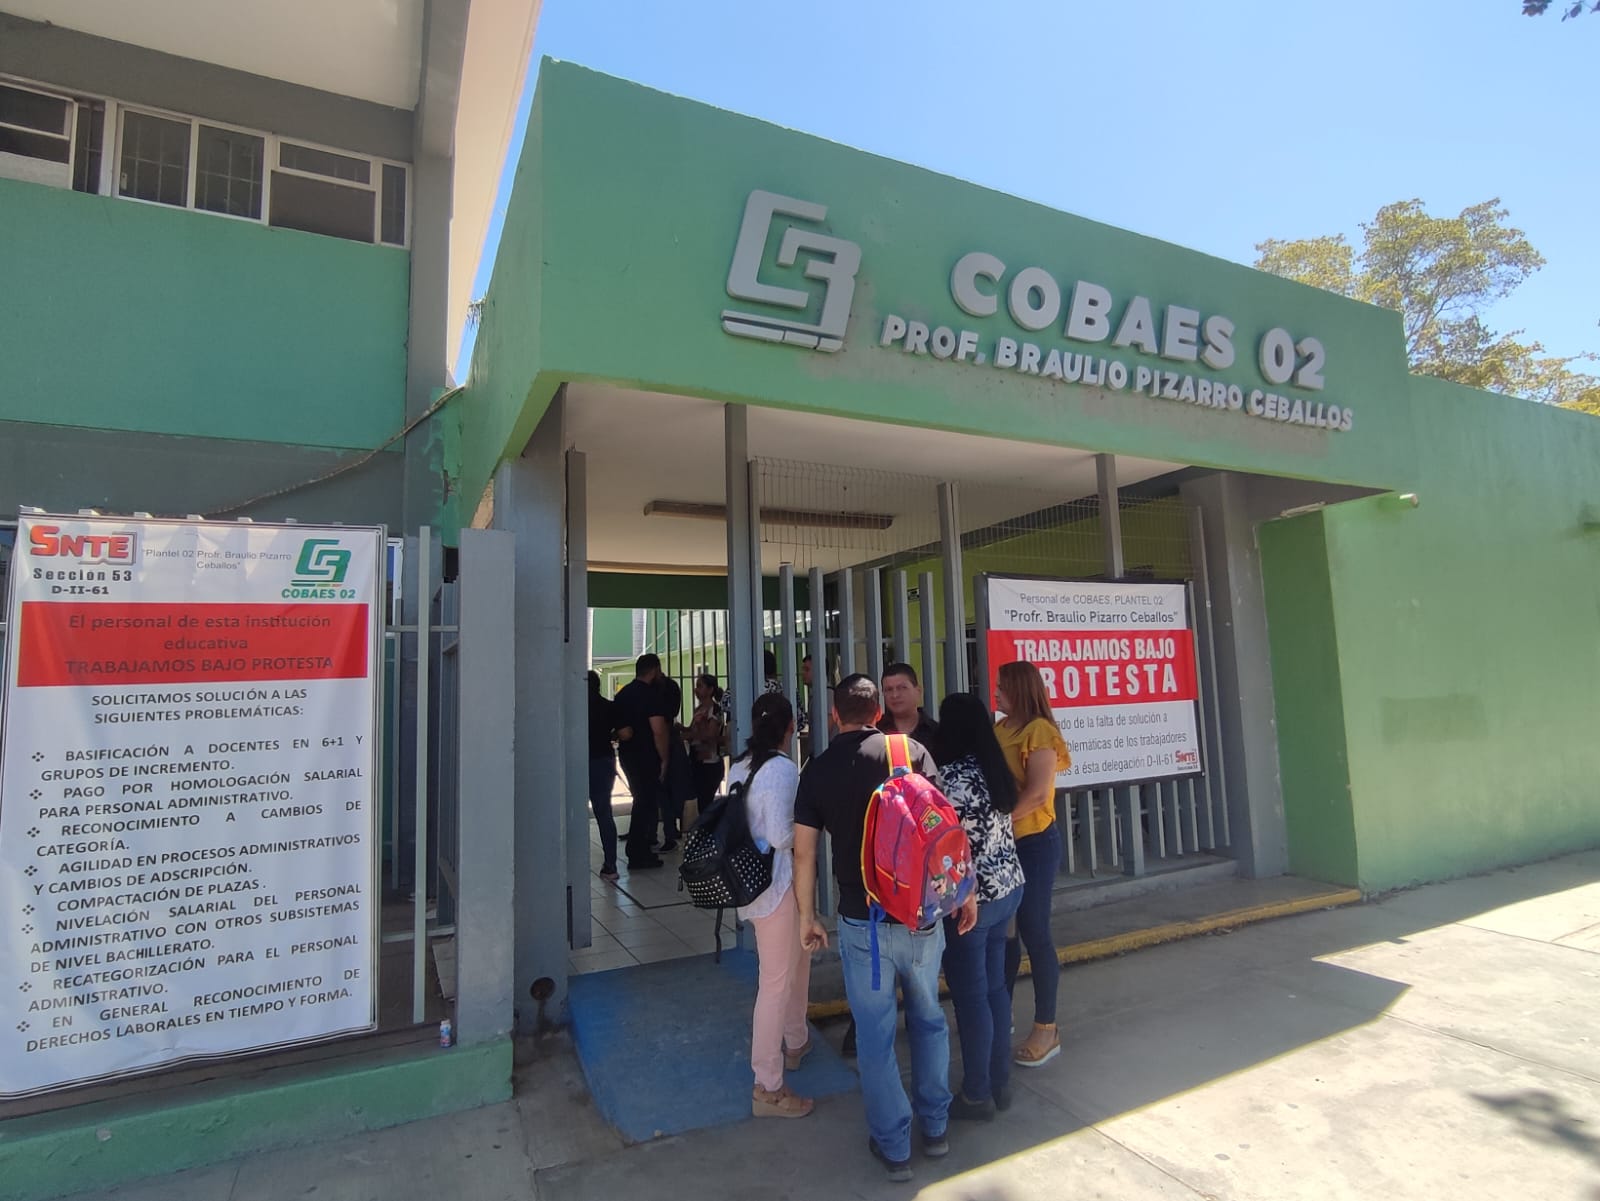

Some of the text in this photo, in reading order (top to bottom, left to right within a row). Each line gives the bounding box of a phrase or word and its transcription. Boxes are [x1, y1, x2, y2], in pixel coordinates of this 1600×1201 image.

[951, 252, 1325, 390] COBAES 02
[880, 314, 1353, 431] PROF. BRAULIO PIZARRO CEBALLOS
[30, 525, 130, 560] SNTE
[182, 550, 194, 558] 02
[225, 551, 257, 560] Braulio
[259, 551, 292, 561] Pizarro
[112, 570, 132, 581] 53
[51, 585, 109, 594] D-II-61
[281, 588, 356, 600] COBAES 02
[1020, 592, 1058, 605] Personal
[1061, 593, 1070, 605] de
[1115, 595, 1151, 605] PLANTEL
[1153, 596, 1164, 605] 02
[69, 614, 331, 631] El personal de esta institución
[1047, 610, 1086, 623] Braulio
[1090, 611, 1128, 623] Pizarro
[164, 637, 248, 650] educativa
[1014, 637, 1175, 663] TRABAJAMOS BAJO
[65, 656, 333, 674] TRABAJAMOS BAJO PROTESTA
[1039, 663, 1178, 699] ROTESTA
[91, 688, 307, 707] SOLICITAMOS SOLUCIÓN A LAS
[95, 705, 304, 724] SIGUIENTES PROBLEMÁTICAS:
[1074, 715, 1084, 728] de
[1087, 714, 1094, 728] la
[1096, 713, 1114, 727] falta
[1116, 713, 1126, 726] de
[1128, 711, 1161, 725] solución
[65, 735, 363, 762] BASIFICACIÓN A DOCENTES EN 6+1 Y
[1114, 736, 1124, 749] de
[1126, 735, 1138, 747] los
[1140, 731, 1187, 747] trabajadores
[41, 760, 235, 782] GRUPOS DE INCREMENTO.
[1102, 756, 1145, 773] delegación
[63, 767, 363, 799] PAGO POR HOMOLOGACIÓN SALARIAL
[39, 789, 294, 819] PARA PERSONAL ADMINISTRATIVO.
[61, 800, 362, 837] RECONOCIMIENTO A CAMBIOS DE
[36, 838, 130, 857] CATEGORÍA.
[58, 833, 361, 874] AGILIDAD EN PROCESOS ADMINISTRATIVOS
[33, 862, 252, 896] Y CAMBIOS DE ADSCRIPCIÓN.
[56, 883, 362, 931] NIVELACIÓN SALARIAL DEL PERSONAL
[57, 887, 180, 912] COMPACTACIÓN
[185, 884, 203, 897] DE
[31, 901, 360, 954] ADMINISTRATIVO CON OTROS SUBSISTEMAS
[31, 939, 215, 973] DE NIVEL BACHILLERATO.
[52, 934, 359, 990] RECATEGORIZACIÓN PARA EL PERSONAL
[28, 983, 169, 1012] ADMINISTRATIVO.
[52, 968, 361, 1028] EN GENERAL RECONOCIMIENTO DE
[26, 987, 353, 1052] DERECHOS LABORALES EN TIEMPO Y FORMA.
